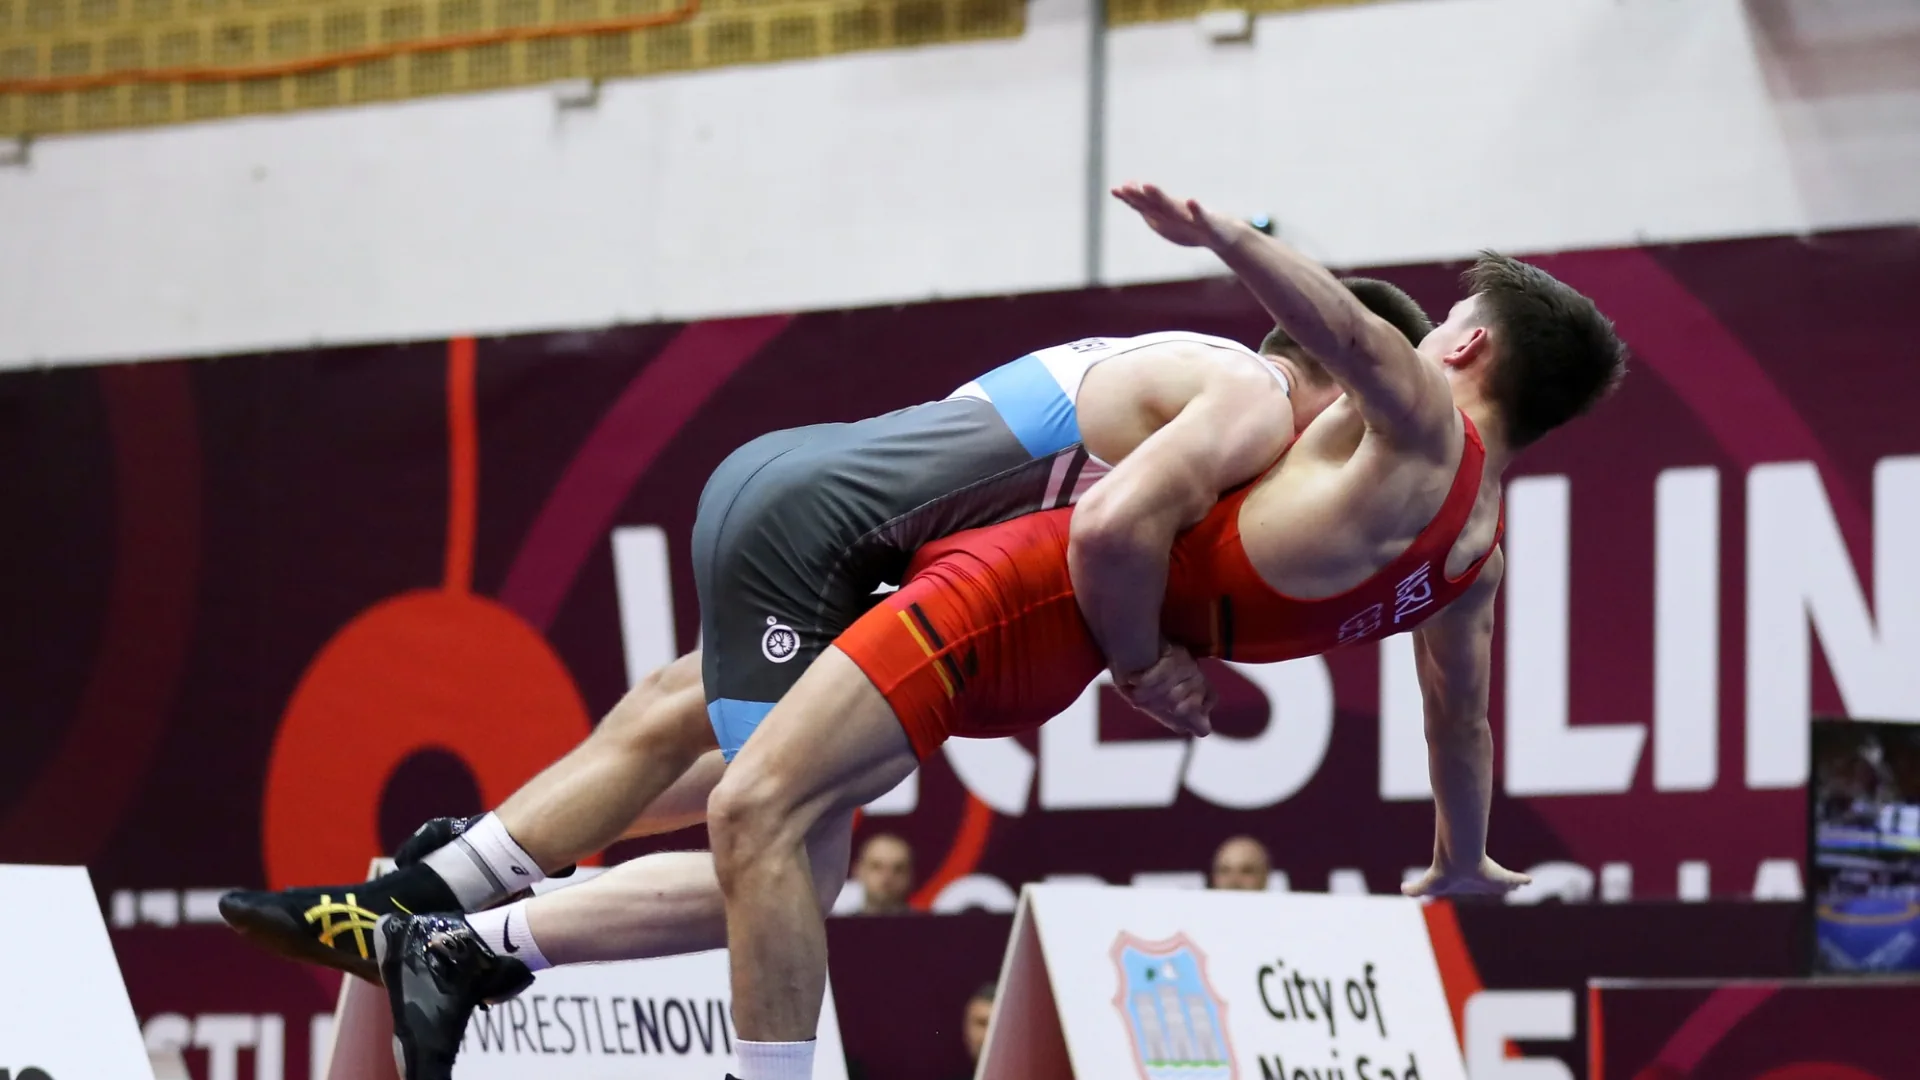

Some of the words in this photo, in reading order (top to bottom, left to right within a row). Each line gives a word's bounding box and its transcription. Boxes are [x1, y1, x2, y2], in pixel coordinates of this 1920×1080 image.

[611, 455, 1920, 817] SLIN
[463, 994, 733, 1057] WRESTLENOVI
[1257, 957, 1336, 1038] City
[1345, 962, 1388, 1039] of
